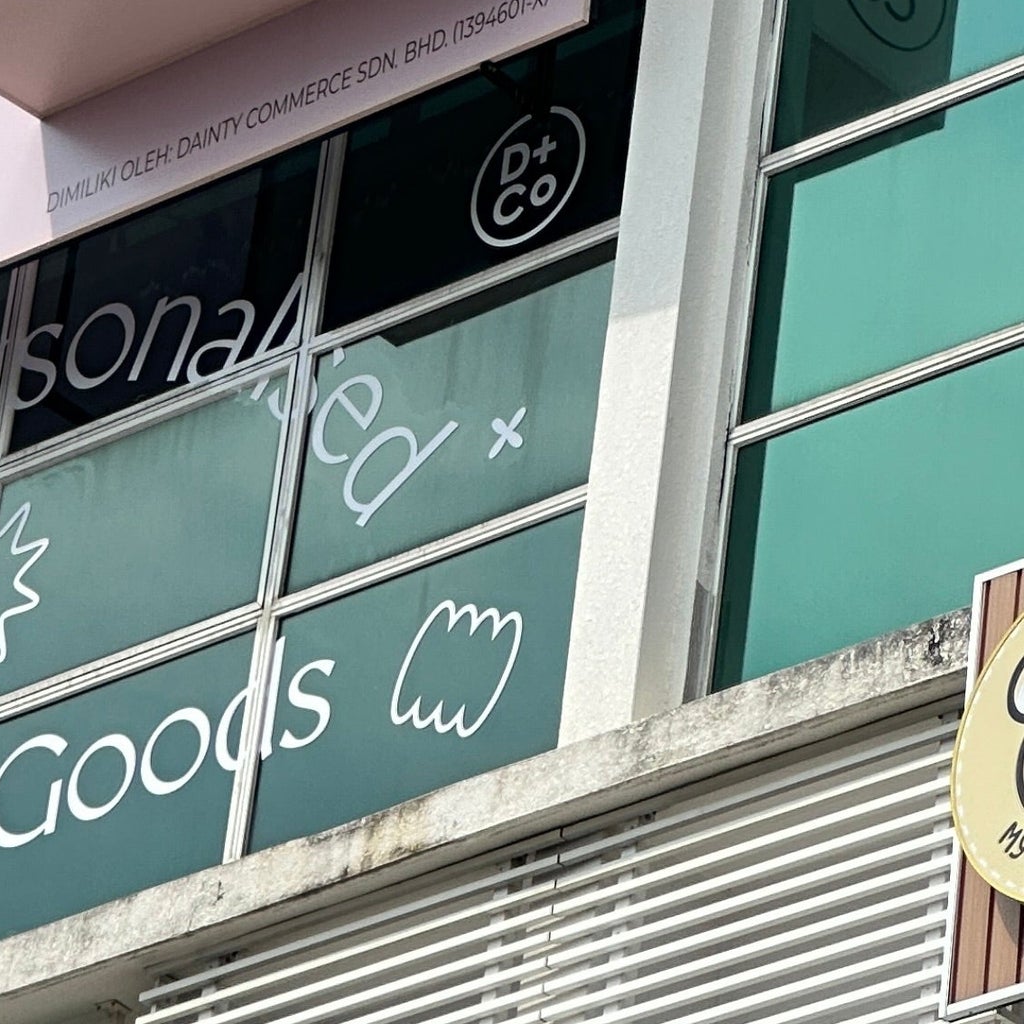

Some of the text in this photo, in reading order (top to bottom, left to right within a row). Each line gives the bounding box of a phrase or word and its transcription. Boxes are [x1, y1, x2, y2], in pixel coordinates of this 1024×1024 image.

[47, 164, 117, 213] DIMILIKI
[120, 143, 173, 182] OLEH:
[176, 112, 245, 160] DAINTY
[245, 67, 353, 129] COMMERCE
[356, 47, 398, 84] SDN.
[404, 29, 448, 64] BHD.
[500, 135, 557, 185] D+
[492, 174, 557, 226] Co
